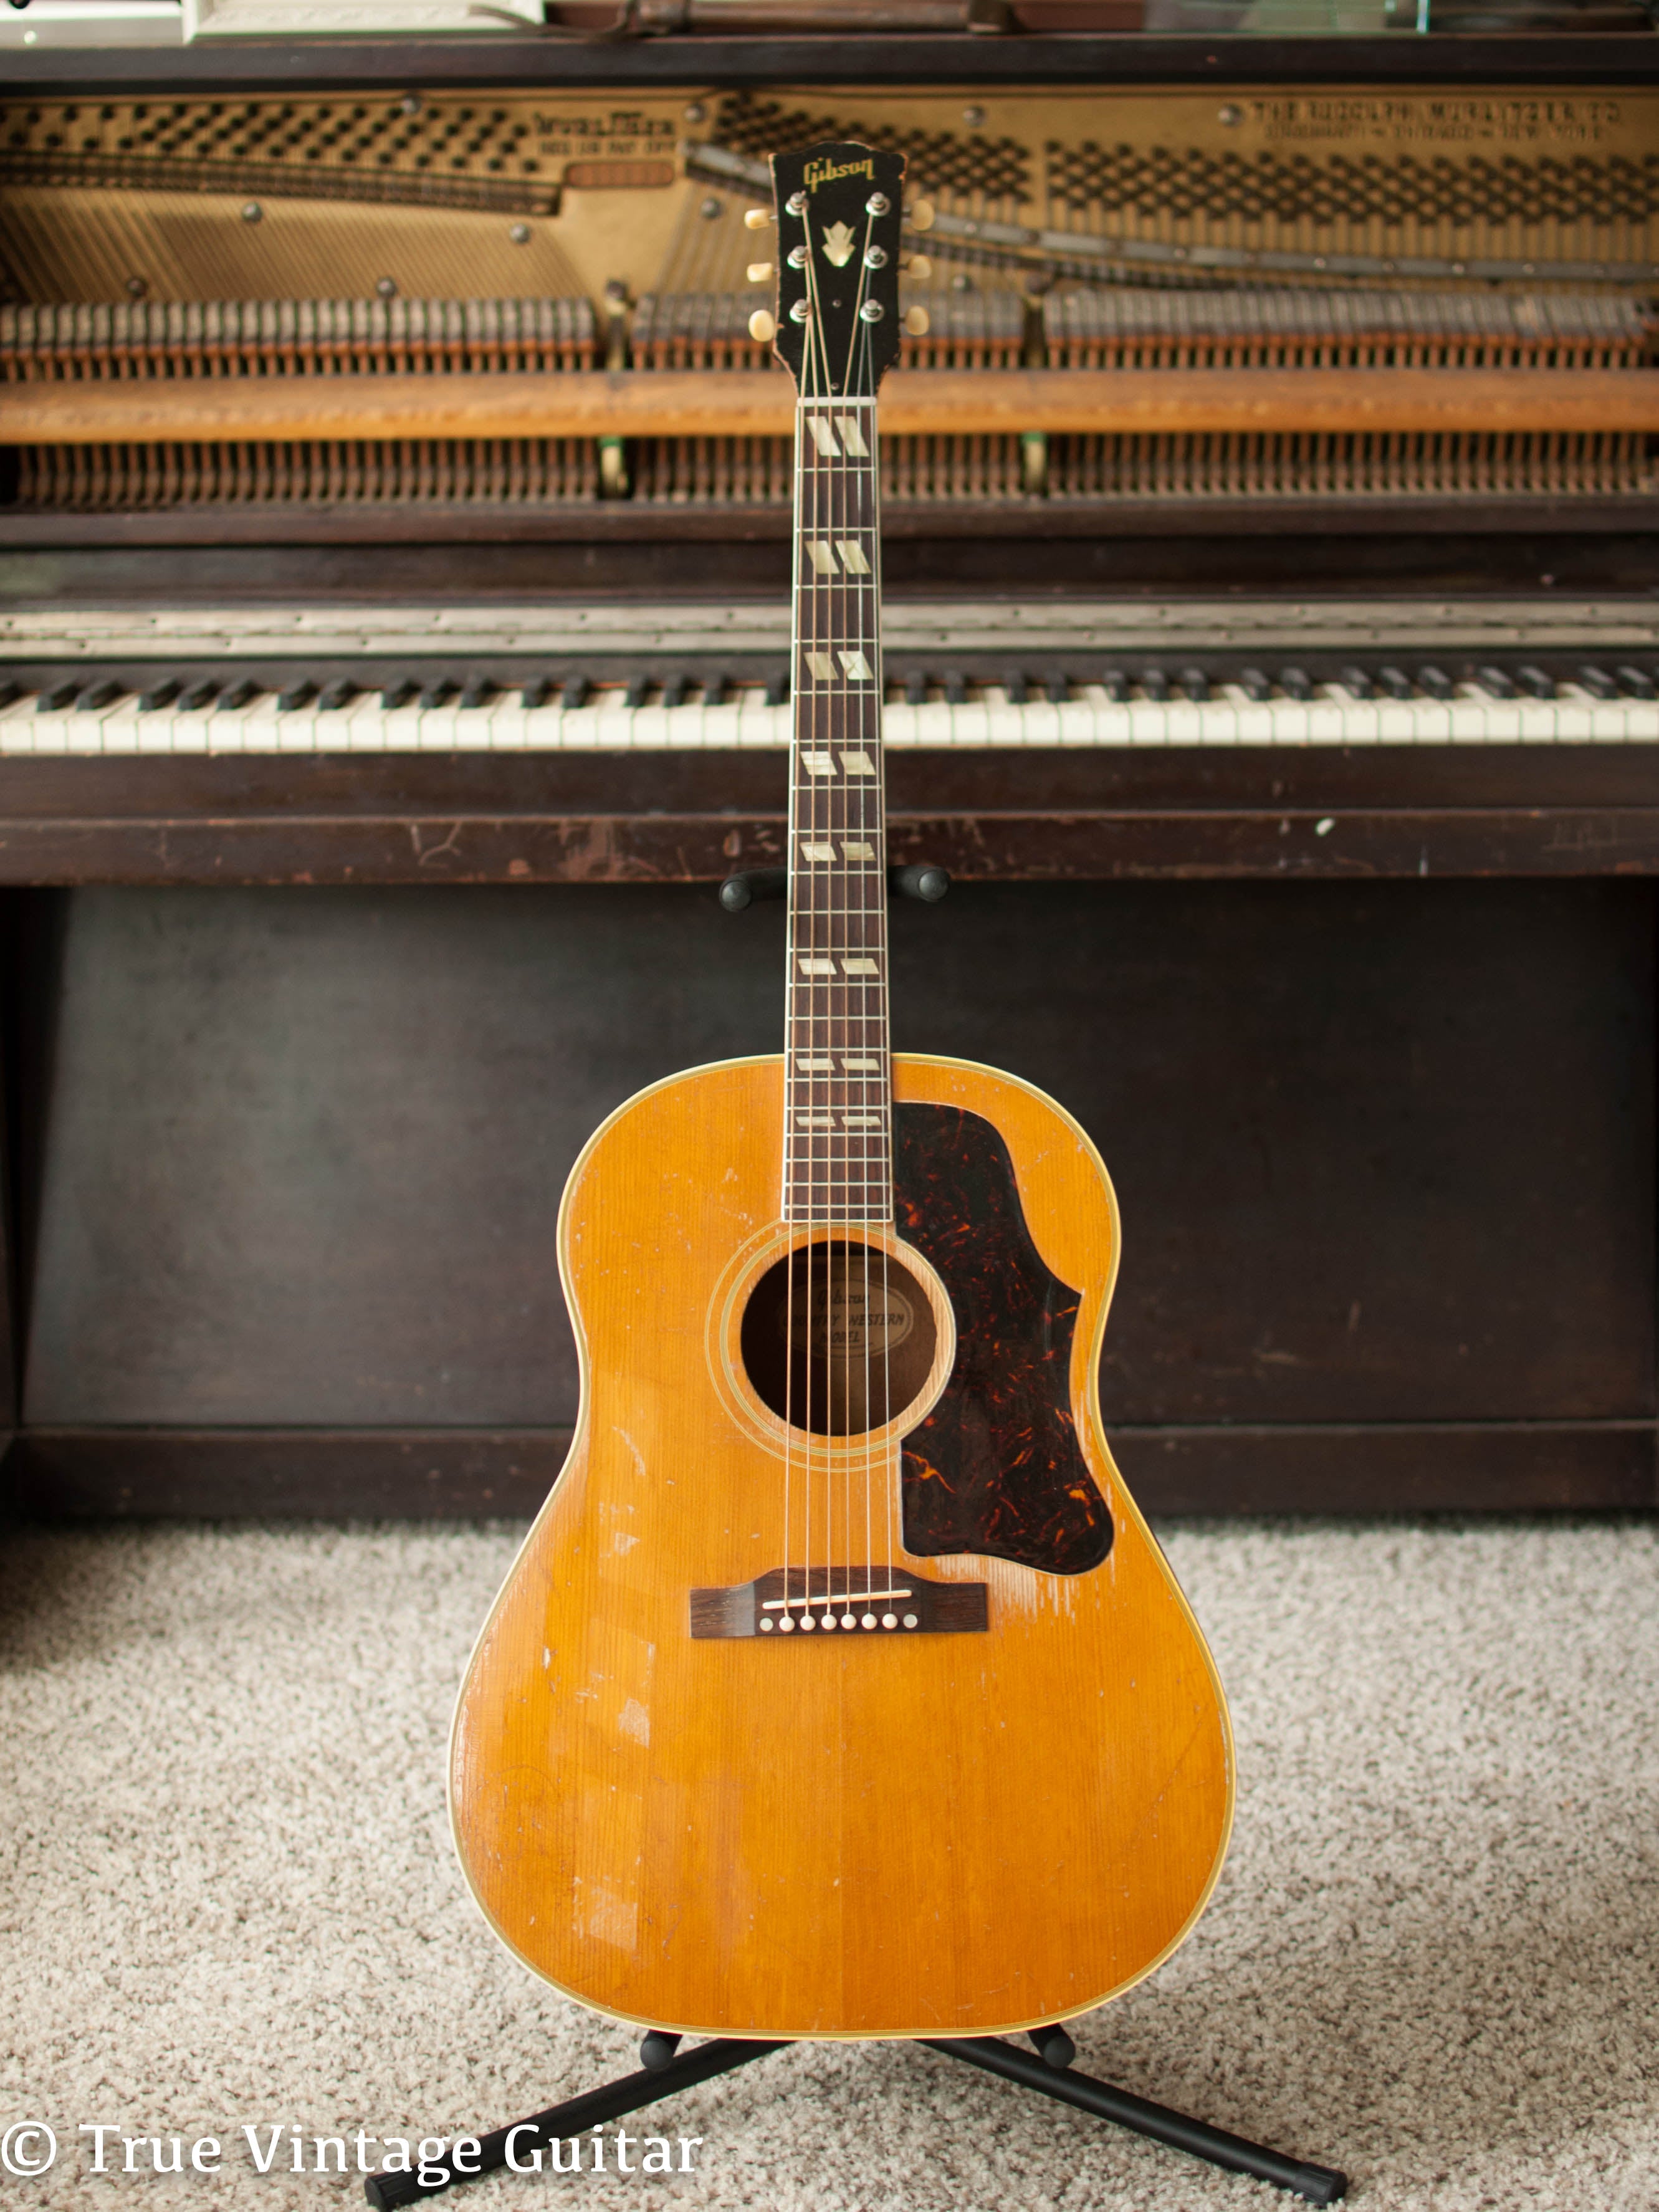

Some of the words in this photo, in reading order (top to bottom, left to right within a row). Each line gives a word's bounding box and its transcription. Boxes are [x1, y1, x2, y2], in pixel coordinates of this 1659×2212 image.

[803, 157, 877, 194] Gibson
[817, 1288, 871, 1313] Gbson
[849, 1313, 904, 1326] WESTERN
